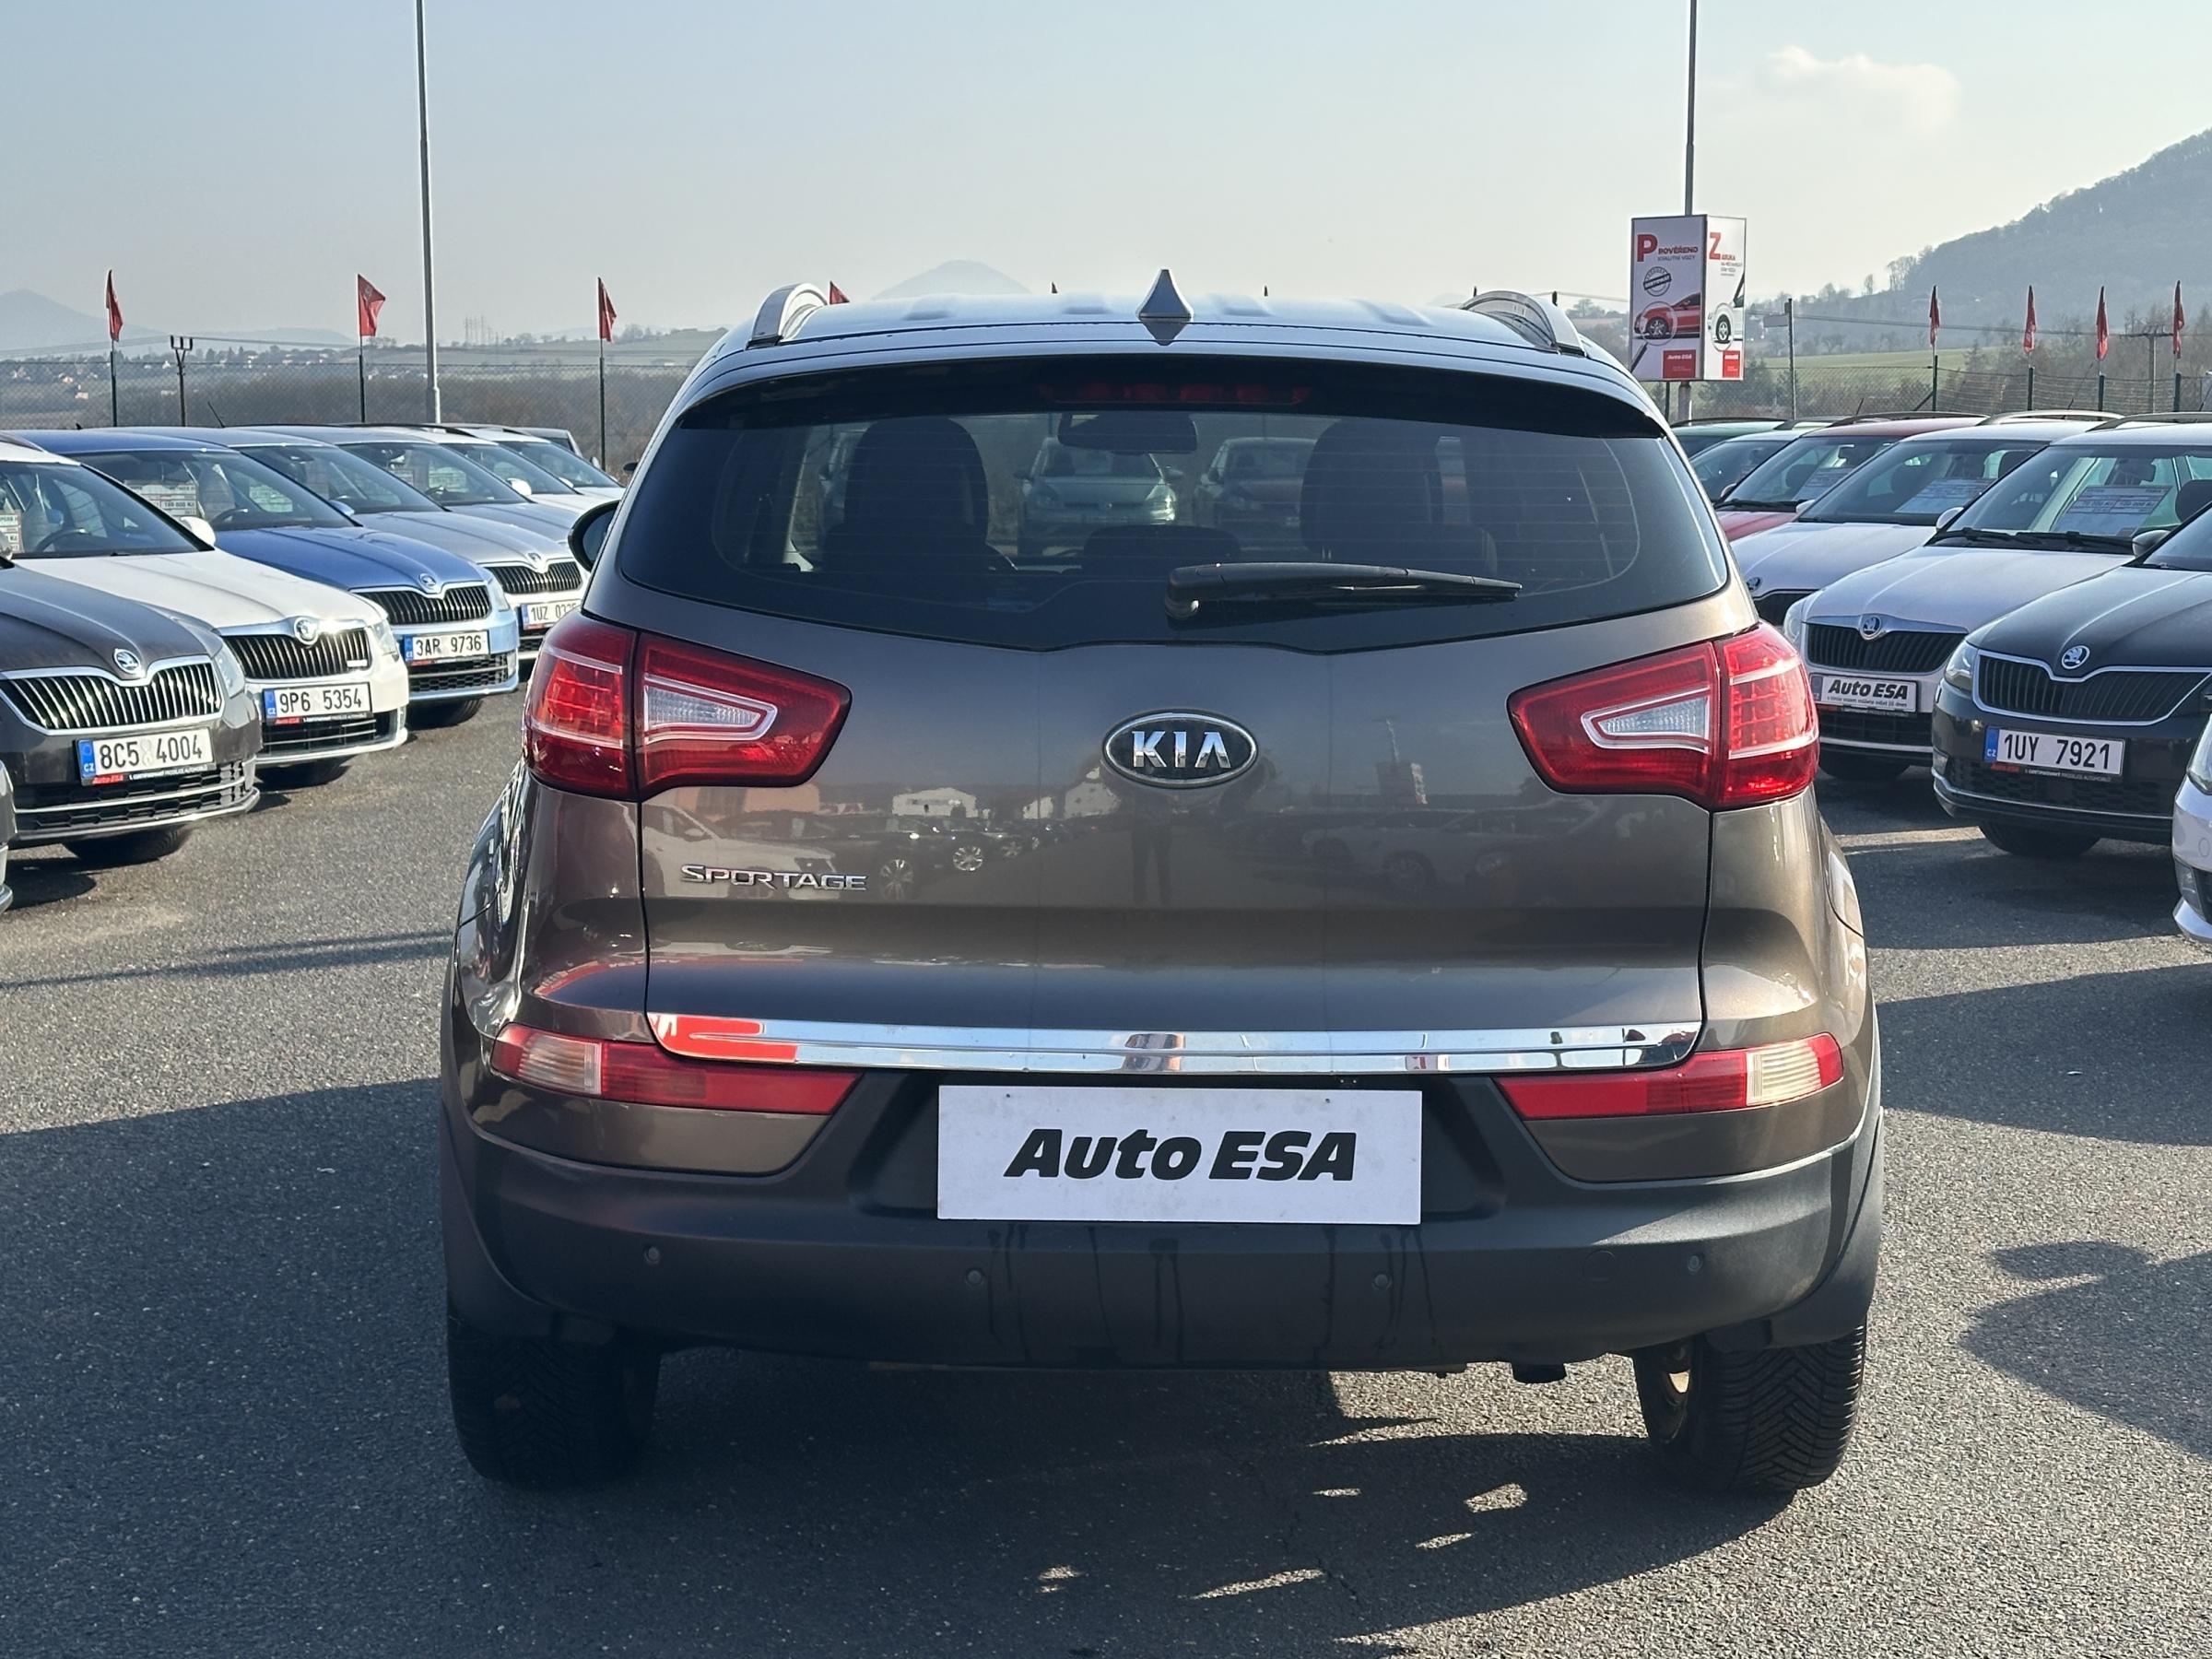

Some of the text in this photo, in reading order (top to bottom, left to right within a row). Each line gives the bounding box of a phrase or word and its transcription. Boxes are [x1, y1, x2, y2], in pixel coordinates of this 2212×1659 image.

[531, 606, 548, 621] 1UZ
[416, 638, 441, 656] 3AR
[451, 635, 482, 653] 9736
[279, 691, 311, 713] 9P6
[323, 688, 362, 710] 5354
[1828, 679, 1872, 697] Auto
[1872, 683, 1909, 700] ESA
[83, 735, 202, 772] CZ 8C5 4004
[1131, 731, 1231, 769] KIA
[1986, 734, 2110, 770] CZ 1UY 7921
[680, 865, 867, 891] SPORTAGE
[1003, 1129, 1357, 1182] Auto ESA
